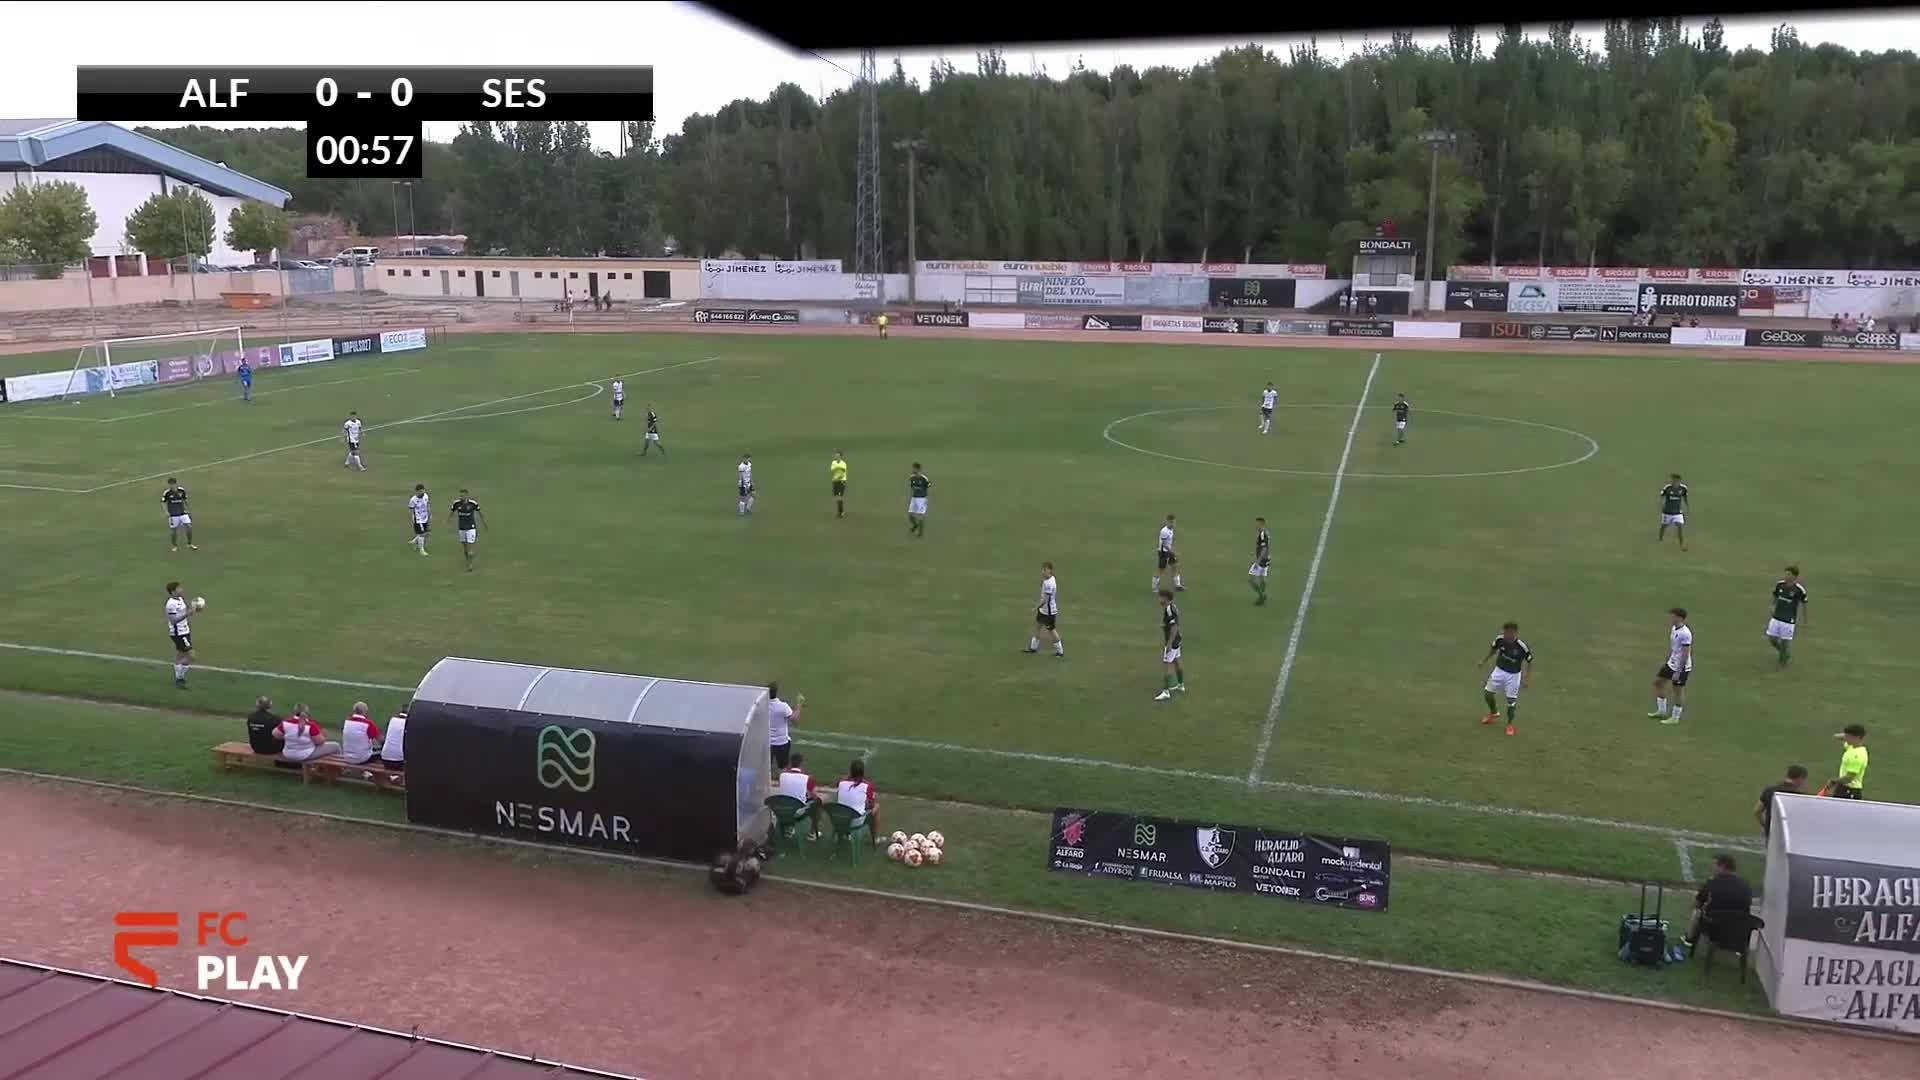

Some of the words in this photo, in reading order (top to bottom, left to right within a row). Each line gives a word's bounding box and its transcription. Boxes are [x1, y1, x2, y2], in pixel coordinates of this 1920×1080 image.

[726, 265, 767, 273] JIMENEZ
[1045, 278, 1086, 286] NINFEO
[1774, 276, 1835, 285] JIMENEZ
[1045, 288, 1066, 296] DEL
[1070, 288, 1096, 296] VINO
[1233, 298, 1268, 306] NESMAR
[1660, 294, 1736, 308] FERROTORRES
[916, 314, 963, 324] VETONEK
[1643, 332, 1669, 340] STUDIO
[1761, 331, 1806, 342] GeBox
[494, 799, 638, 843] NESMAR
[1254, 840, 1299, 852] HERACLIO
[1056, 849, 1084, 858] ALFARO
[1117, 848, 1167, 862] NESMAR
[1268, 851, 1305, 864] ALFARO
[1322, 857, 1382, 871] mockupdental
[1148, 869, 1183, 880] FRUALSA
[1253, 866, 1306, 880] BONDALTI
